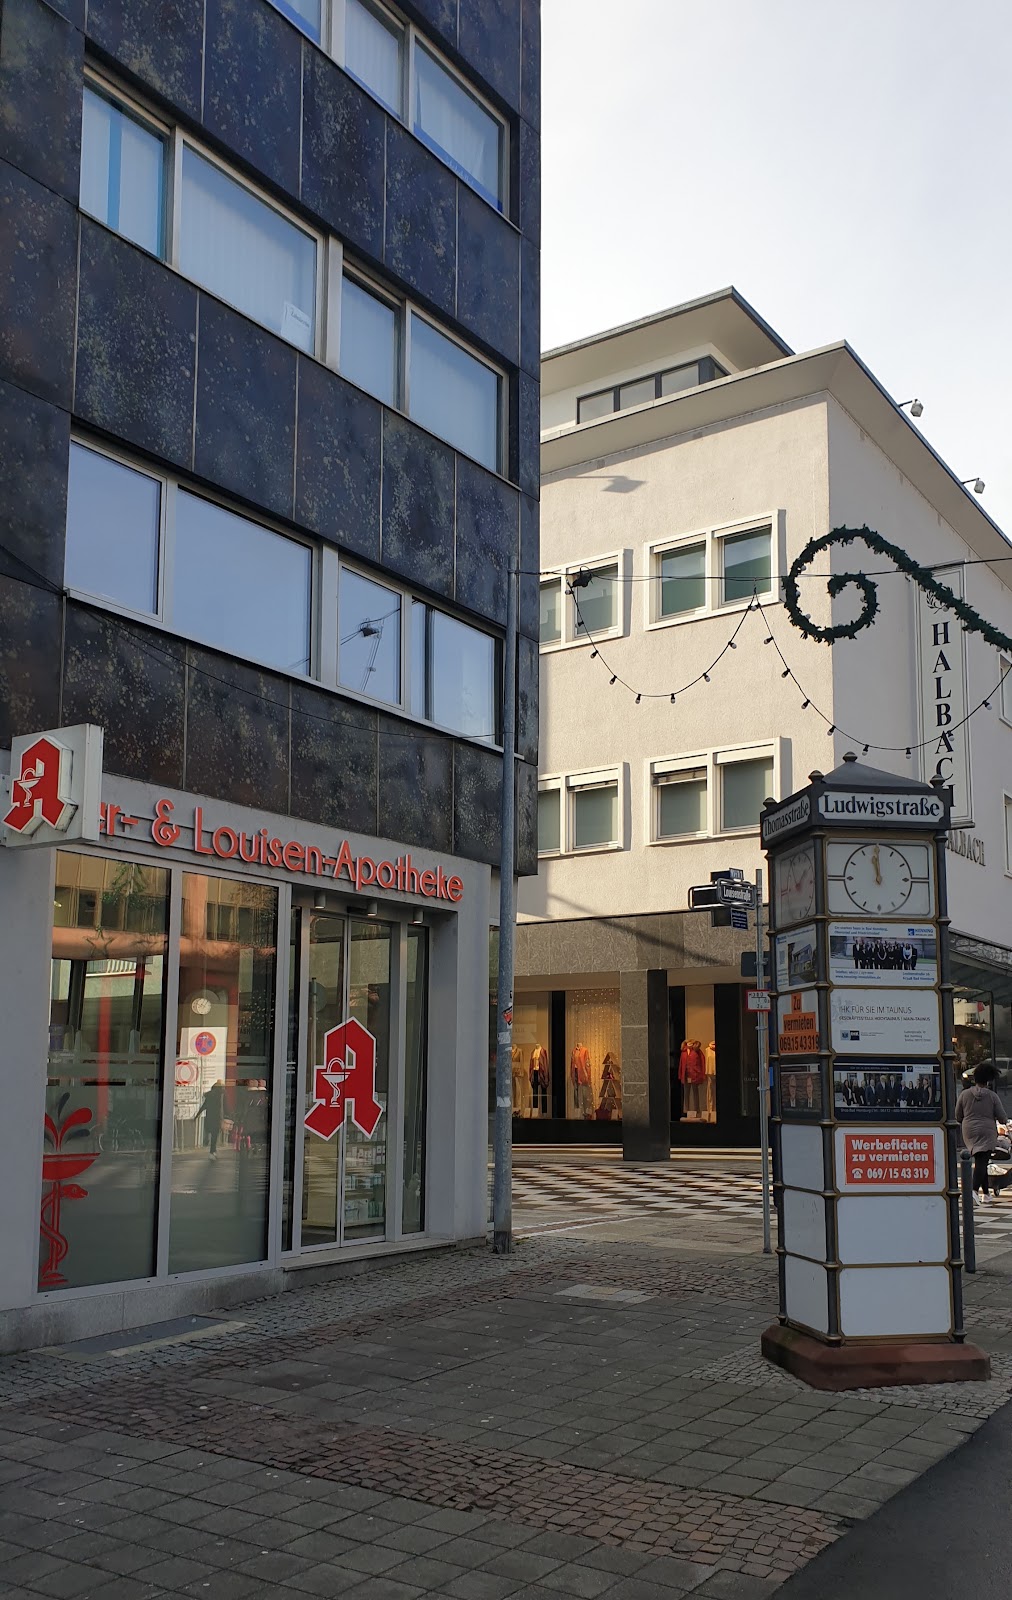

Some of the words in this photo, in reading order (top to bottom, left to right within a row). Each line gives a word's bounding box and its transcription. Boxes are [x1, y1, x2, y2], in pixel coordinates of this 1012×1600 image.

[823, 794, 940, 818] Ludwigstraße
[763, 800, 810, 837] Thomasstraße
[151, 798, 181, 847] &
[194, 806, 464, 903] Louisen-Apotheke
[945, 829, 986, 867] ALBACH
[723, 885, 751, 902] Louisenstraße
[793, 995, 801, 1011] Zu
[839, 1005, 850, 1014] IHK
[851, 1005, 864, 1014] FÜR
[866, 1006, 875, 1014] SIE
[876, 1006, 885, 1014] IM
[886, 1006, 912, 1014] TAUNUS
[783, 1015, 814, 1032] vermieten
[851, 1138, 929, 1151] Werbefläche
[851, 1152, 866, 1162] zu
[869, 1150, 929, 1162] vermieten
[867, 1167, 899, 1180] 069/15
[900, 1167, 912, 1179] 43
[913, 1167, 929, 1179] 319
